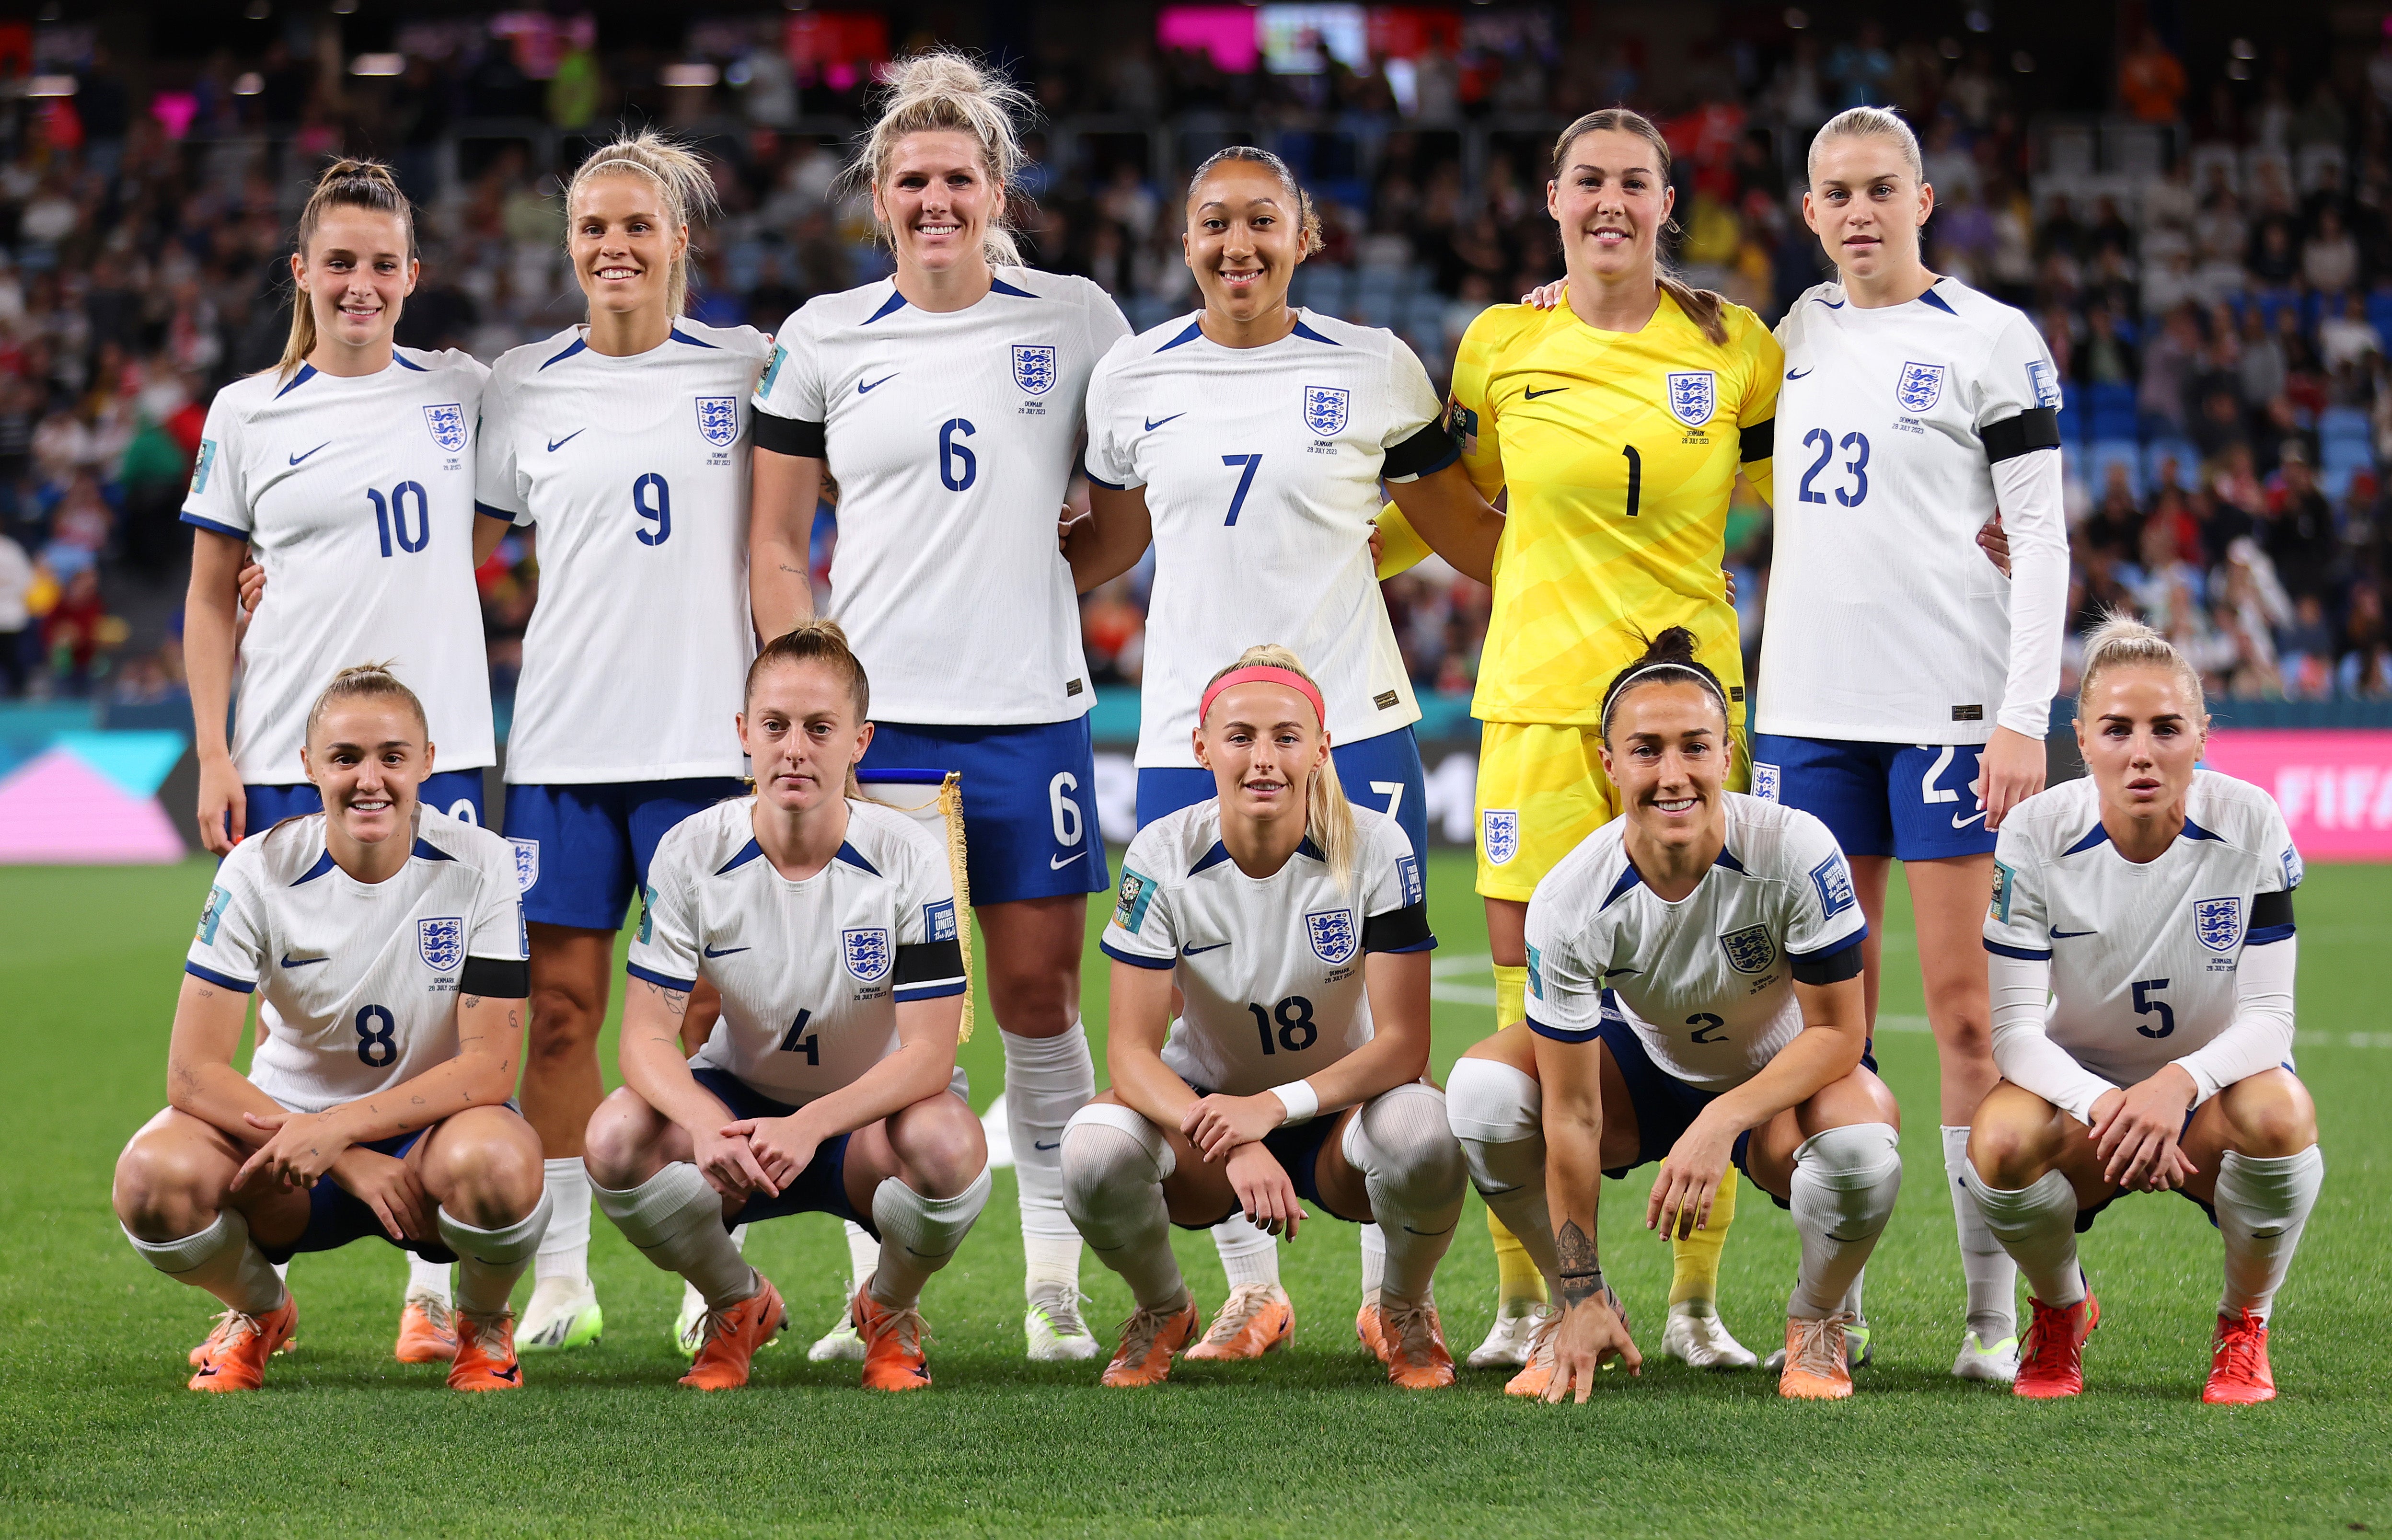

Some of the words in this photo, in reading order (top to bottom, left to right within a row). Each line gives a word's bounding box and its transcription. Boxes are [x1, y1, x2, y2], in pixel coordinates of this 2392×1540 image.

[1899, 416, 1919, 425] DENMARK
[939, 418, 976, 491] 6
[1622, 445, 1641, 516] 1
[1799, 428, 1869, 507] 23
[368, 481, 429, 557] 10
[634, 473, 670, 546] 9
[1222, 454, 1262, 526] 7
[1369, 781, 1404, 820] 7
[1916, 744, 1981, 804] 2
[1050, 772, 1082, 846] 6
[935, 908, 953, 920] FOOTBALL
[936, 916, 954, 931] UNITES
[1837, 892, 1848, 900] FIFA
[934, 931, 945, 941] the
[1329, 967, 1350, 976] DENMARK
[356, 1004, 397, 1068] 8
[780, 1008, 819, 1066] 4
[1248, 996, 1317, 1055] 18
[1686, 1012, 1730, 1044] 2
[2131, 978, 2174, 1039] 5
